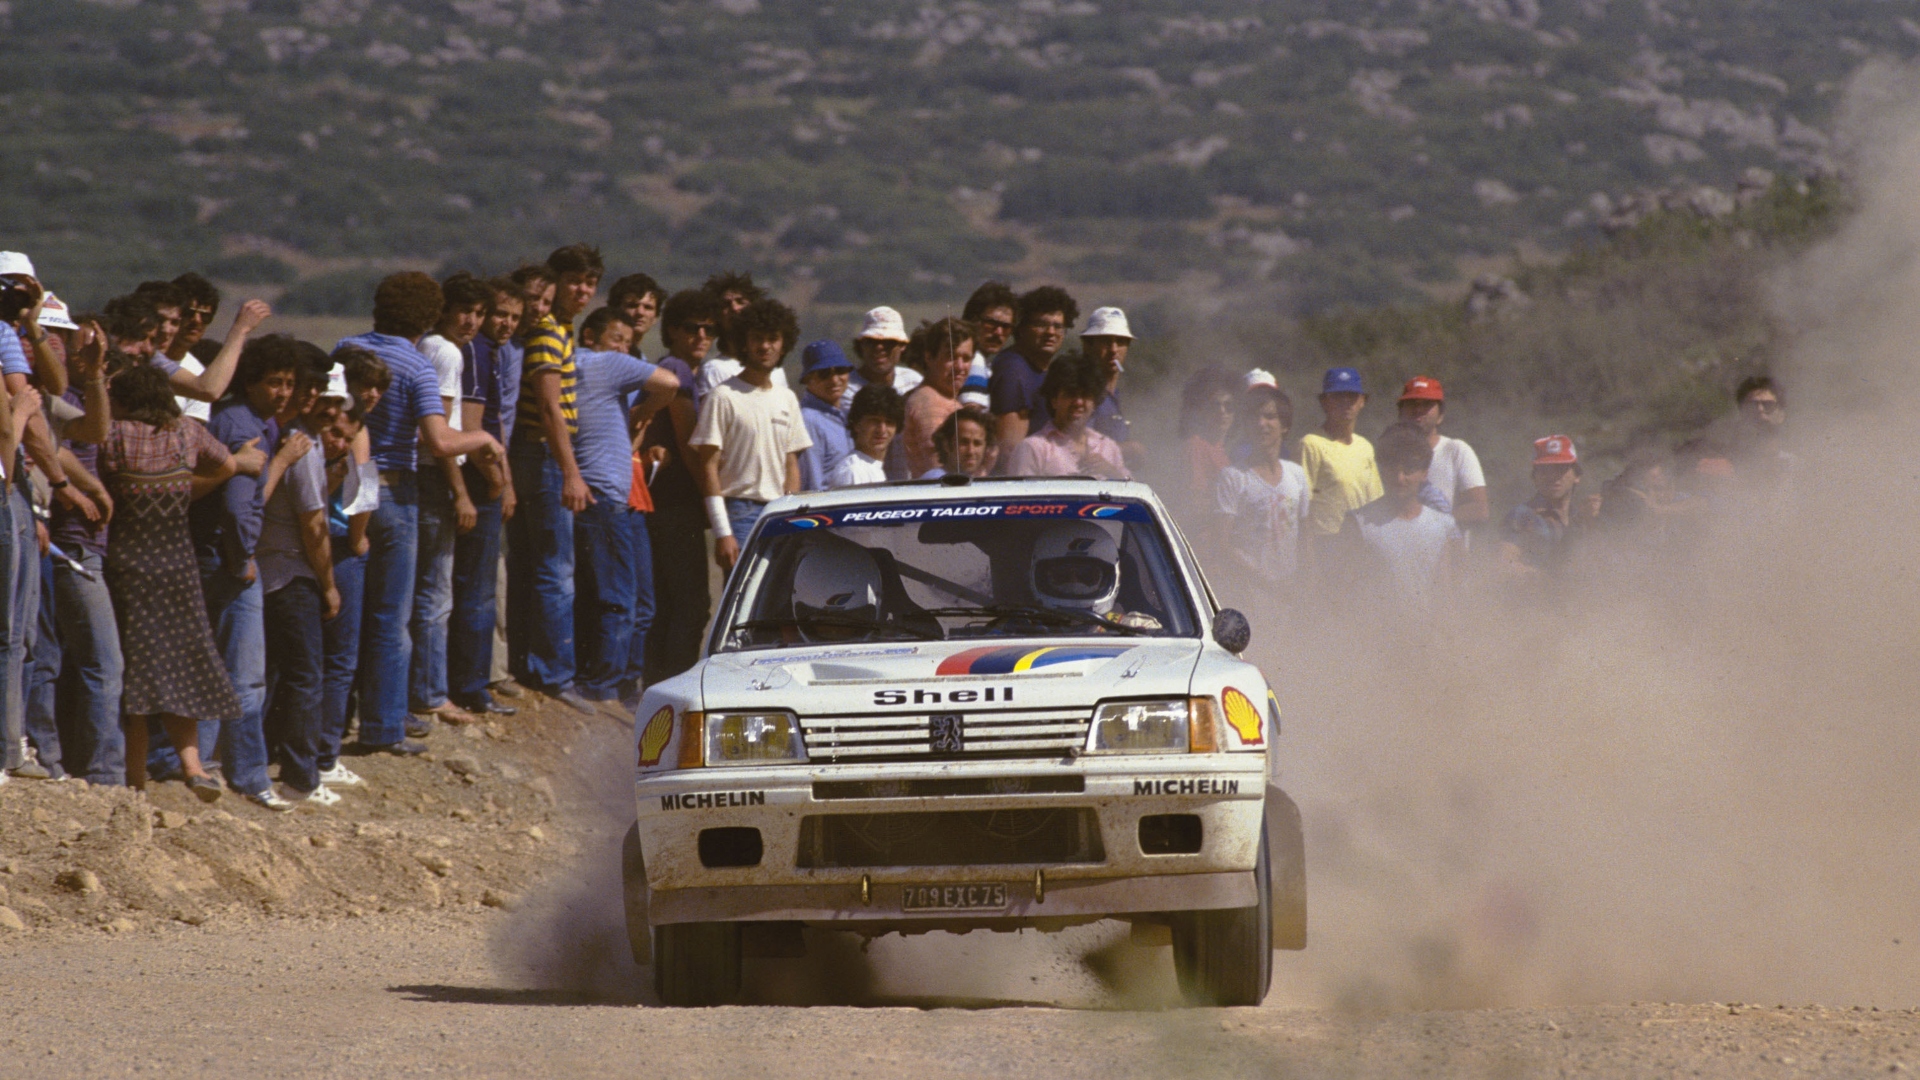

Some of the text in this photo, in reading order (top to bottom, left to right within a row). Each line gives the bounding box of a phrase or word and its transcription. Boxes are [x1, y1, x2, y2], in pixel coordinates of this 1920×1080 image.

[842, 504, 1067, 522] PEUGEOT TALBOT SPORT
[873, 687, 1014, 705] Shell
[1133, 779, 1239, 796] MICHELIN
[661, 790, 765, 811] MICHELIN
